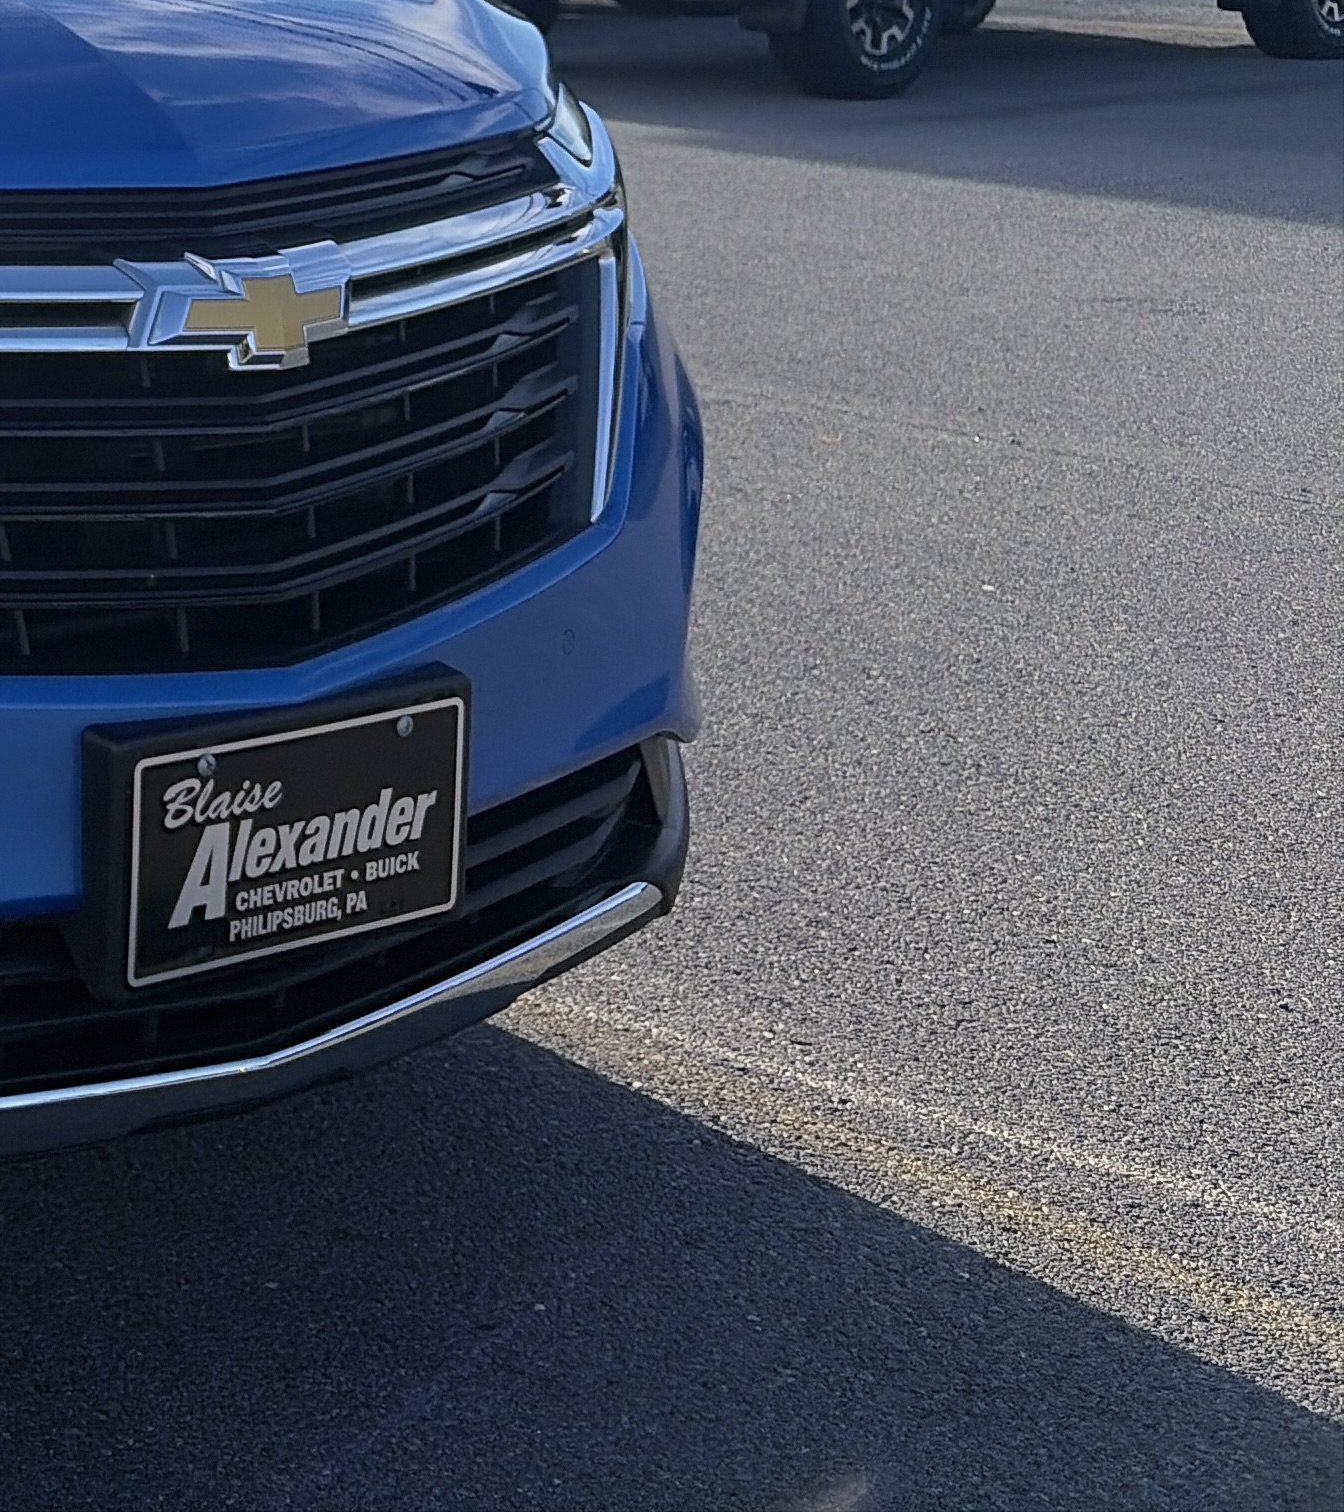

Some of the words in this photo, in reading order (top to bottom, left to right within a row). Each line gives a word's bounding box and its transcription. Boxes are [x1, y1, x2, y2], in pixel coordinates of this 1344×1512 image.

[163, 778, 283, 830] Blaise
[167, 787, 438, 930] Alexander
[235, 869, 345, 912] CHEVROLET
[365, 851, 420, 882] BUICK
[229, 897, 343, 942] PHILIPSBURG,
[346, 890, 368, 915] PA
